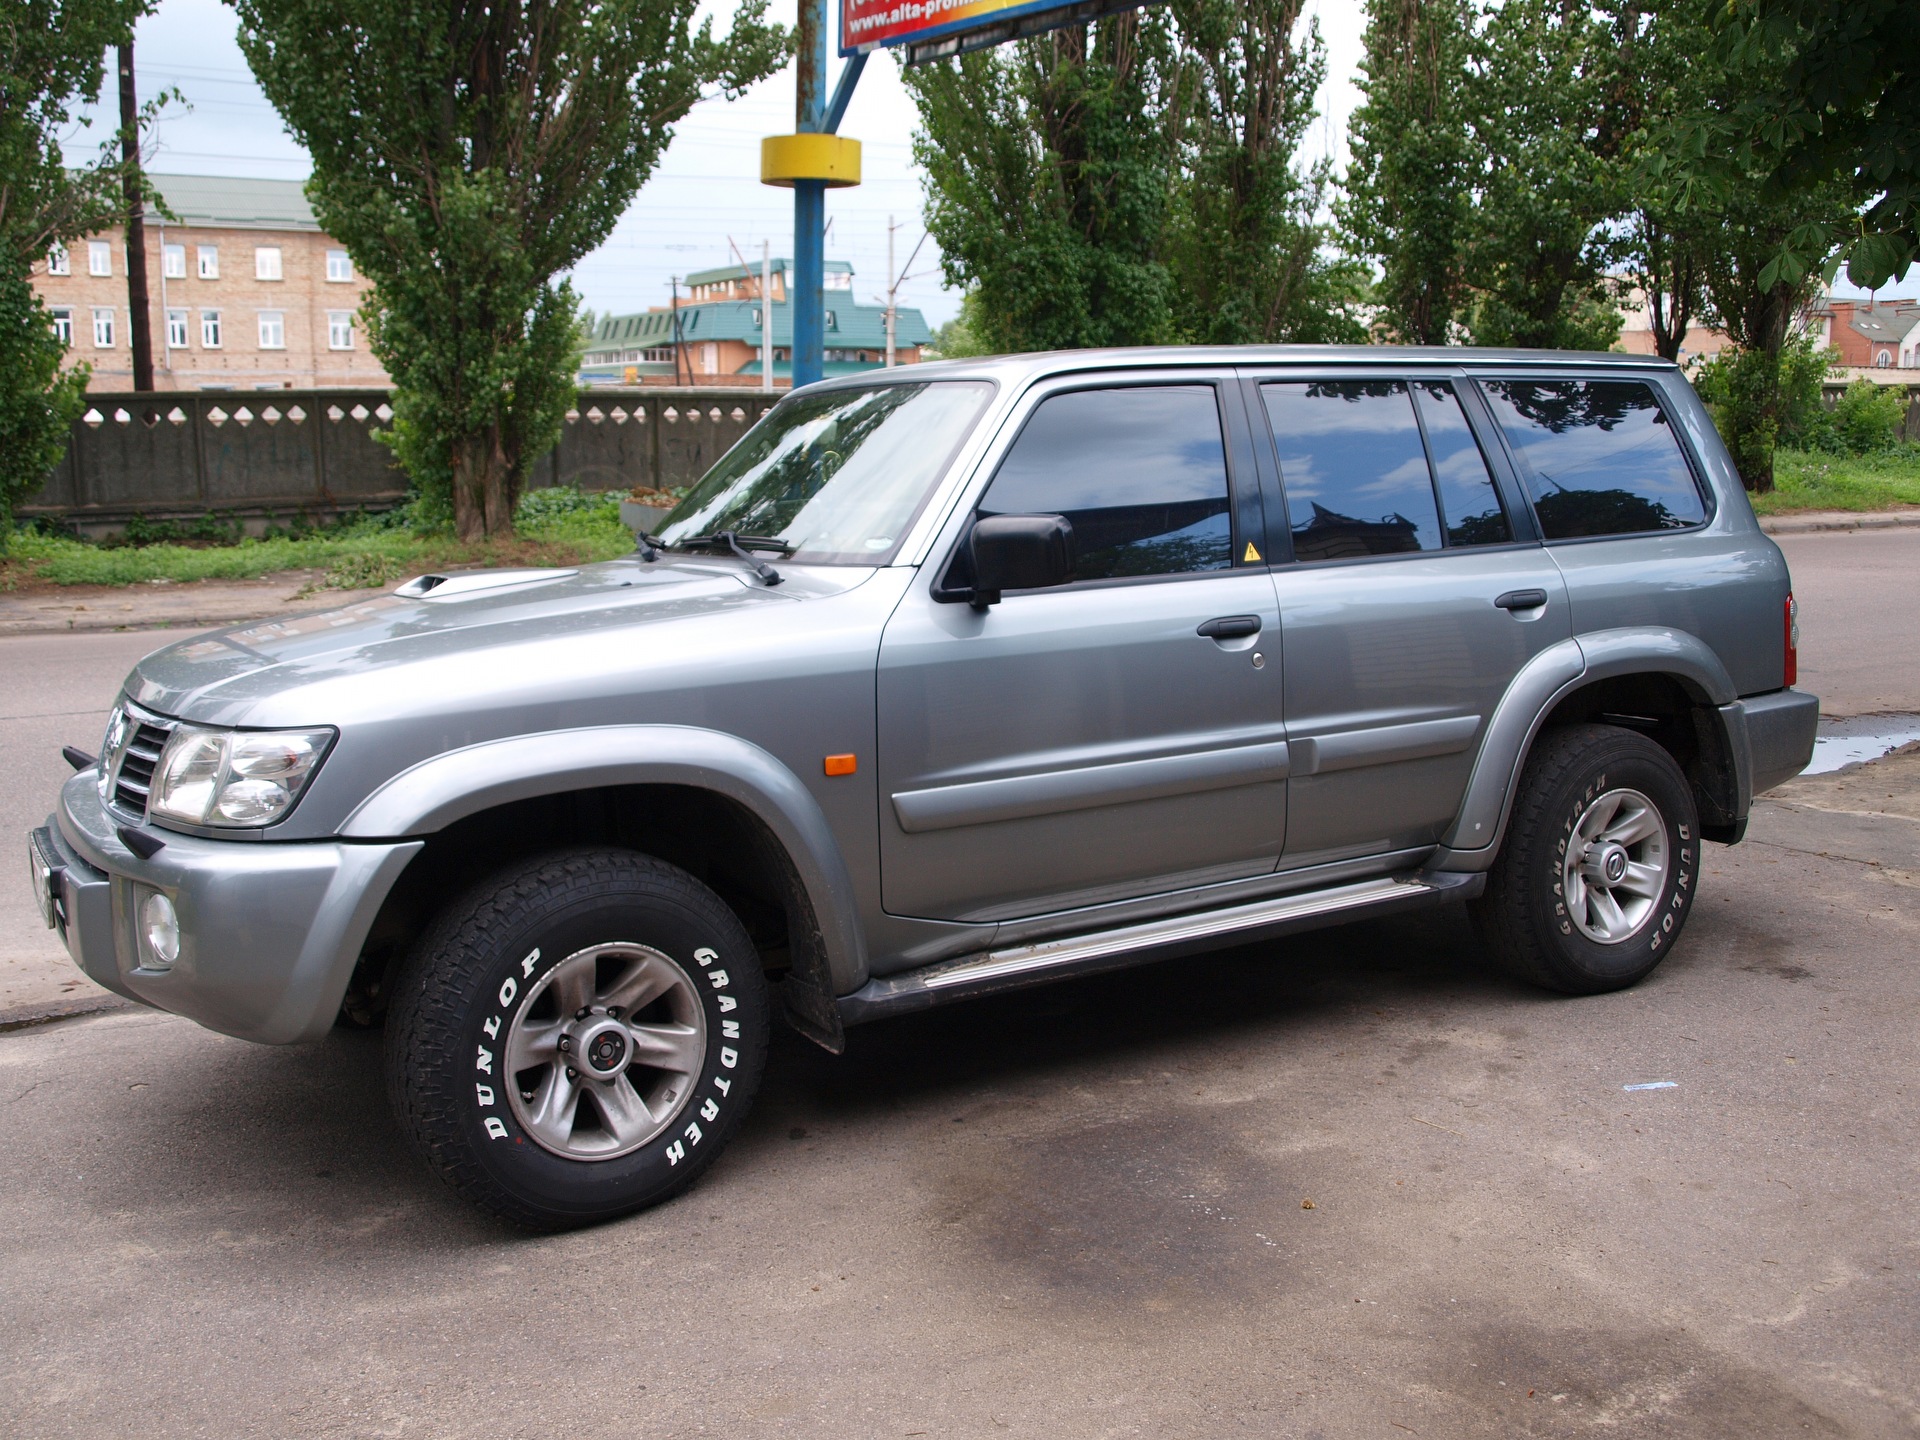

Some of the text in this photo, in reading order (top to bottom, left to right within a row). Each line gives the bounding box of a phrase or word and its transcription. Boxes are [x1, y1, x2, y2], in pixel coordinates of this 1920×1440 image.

[1552, 773, 1607, 936] GRANDTREK
[1651, 823, 1692, 951] DUNLOP
[476, 948, 542, 1141] DUNLOP
[666, 947, 741, 1167] GRANDTREK
